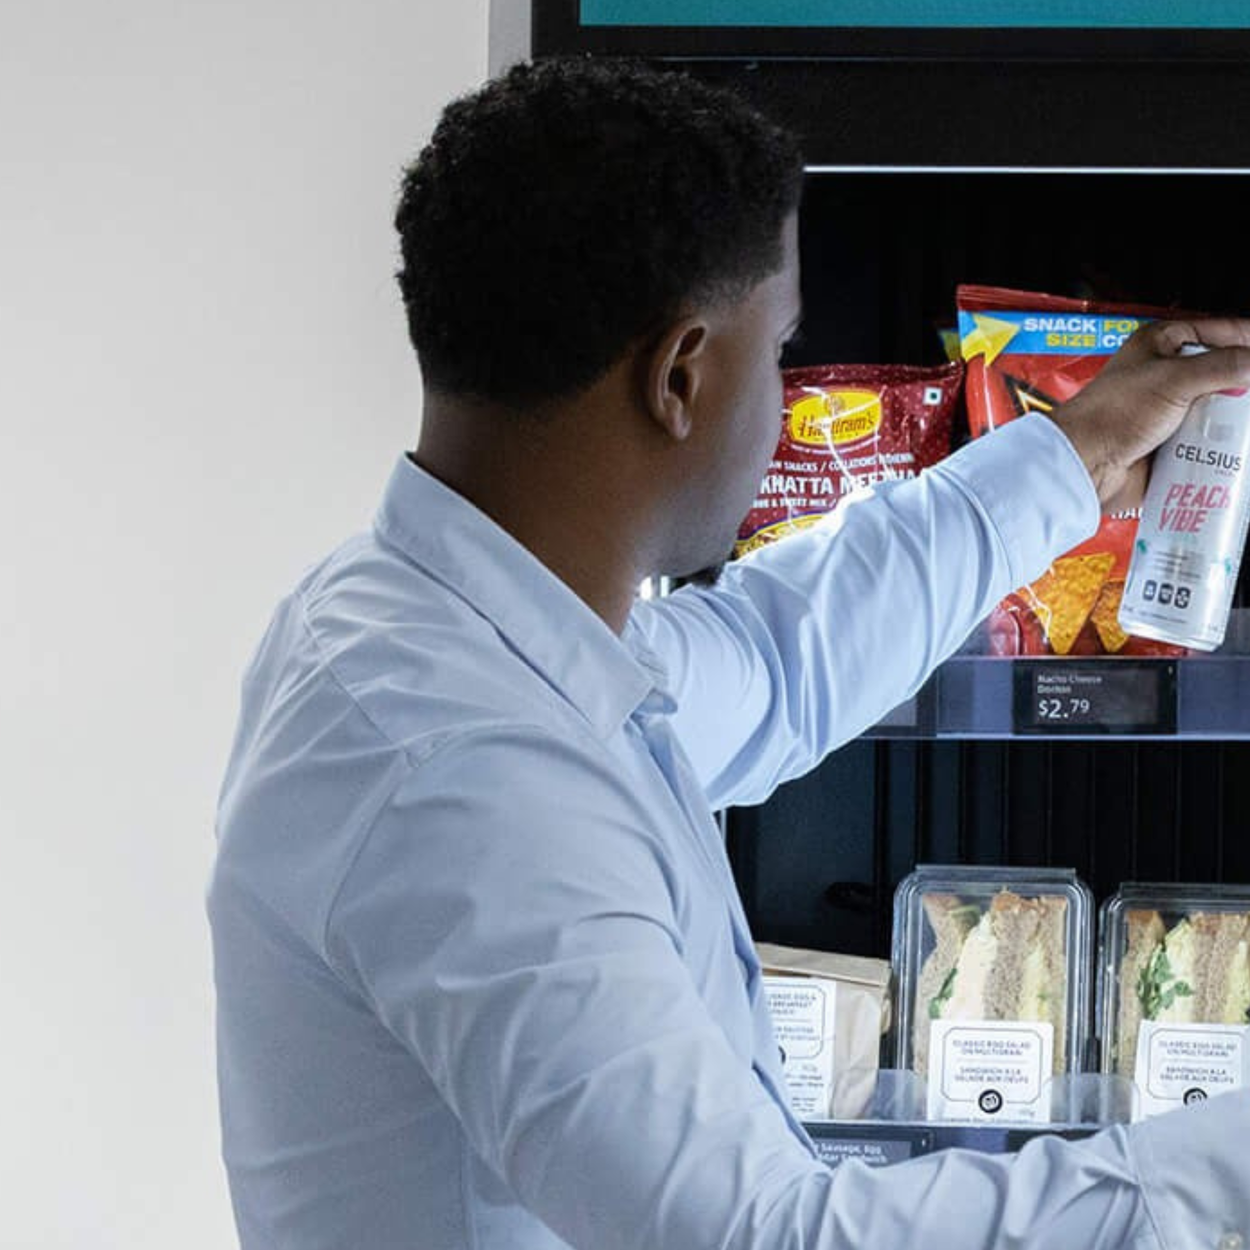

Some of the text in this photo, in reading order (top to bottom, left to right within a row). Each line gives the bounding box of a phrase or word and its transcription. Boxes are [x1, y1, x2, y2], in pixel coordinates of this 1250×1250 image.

[1024, 317, 1096, 332] SNACK
[1046, 333, 1095, 347] SIZE
[798, 412, 876, 438] Hairam's
[1175, 443, 1242, 472] CELSIUS
[760, 475, 834, 495] KHATTA
[1163, 483, 1231, 509] PEACH
[1157, 507, 1209, 534] VIBE
[1038, 699, 1090, 719] $2.79
